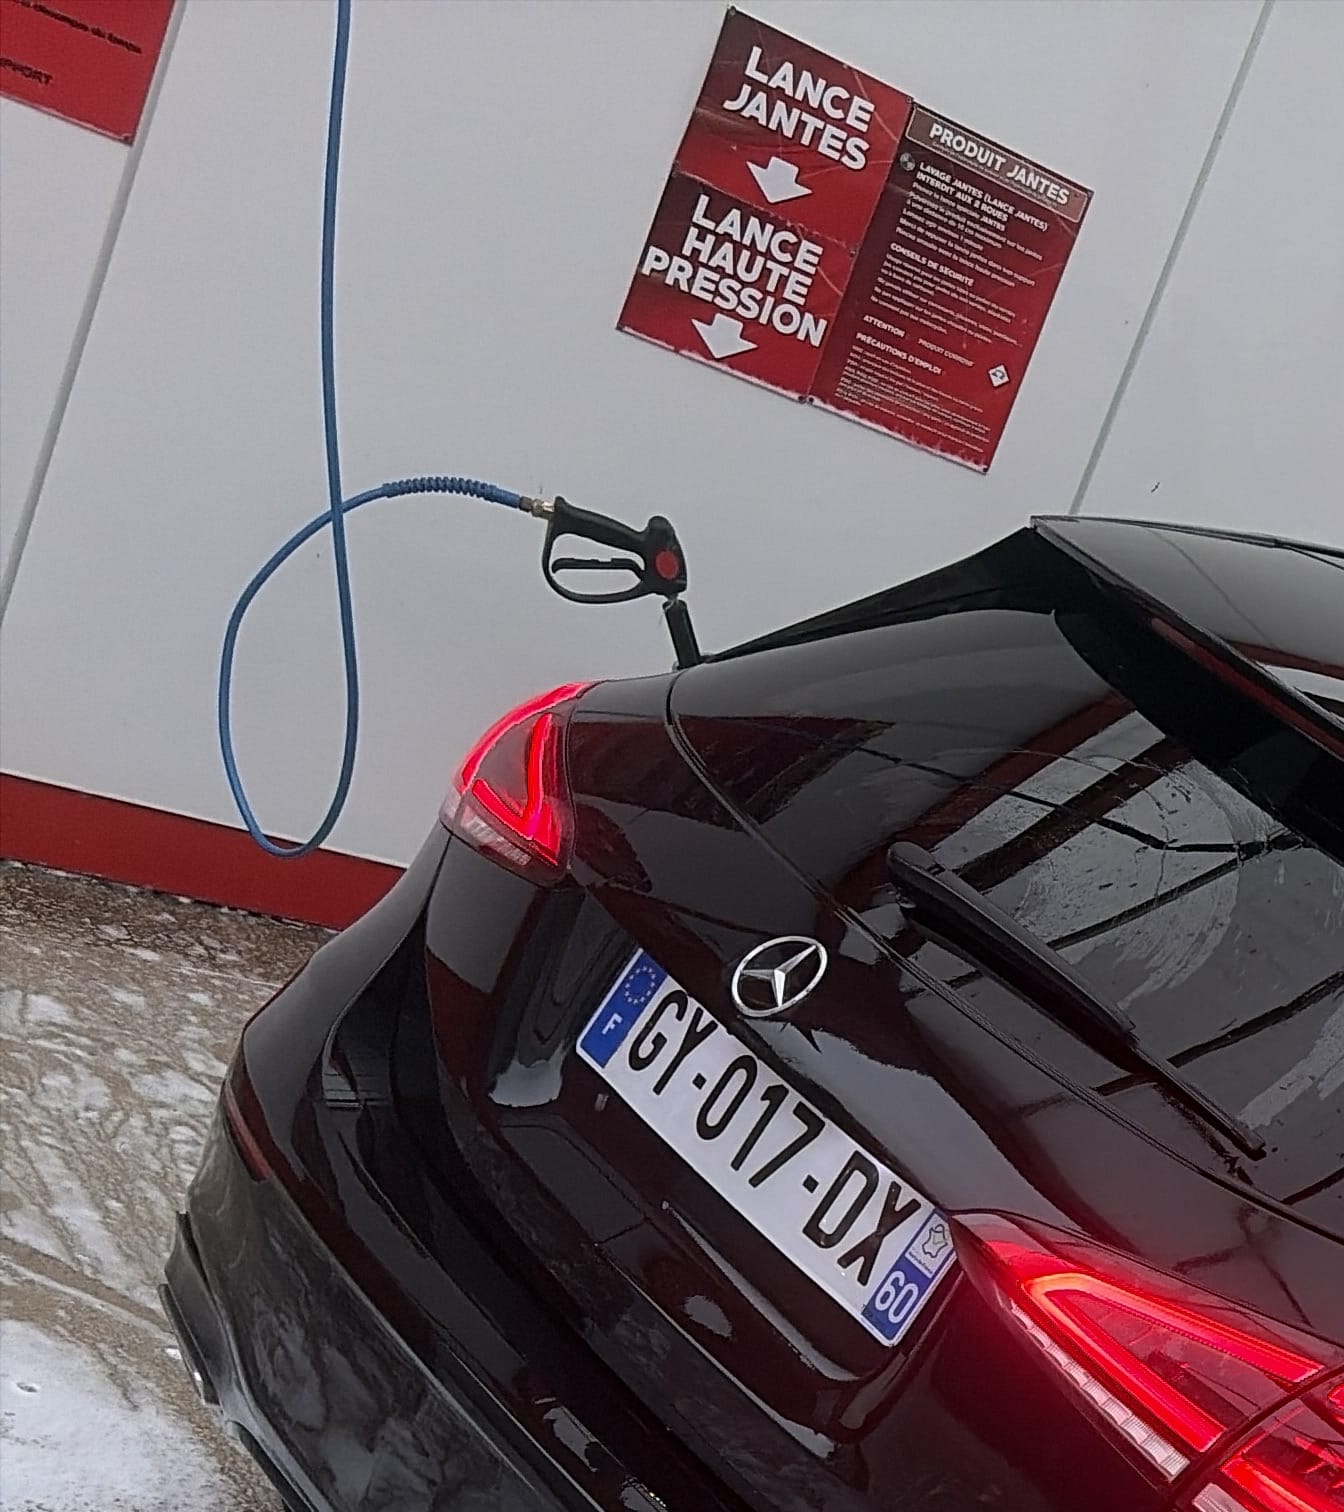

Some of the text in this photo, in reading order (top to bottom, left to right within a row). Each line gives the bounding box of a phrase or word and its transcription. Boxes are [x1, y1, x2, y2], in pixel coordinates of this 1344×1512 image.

[723, 84, 870, 171] JANTES
[744, 46, 875, 133] LANCE
[915, 171, 955, 196] INTERDIT
[954, 190, 973, 204] AUX
[980, 202, 1008, 222] ROUES
[918, 161, 1049, 233] LAVAGE JANTES (LANCE JANTES)
[928, 122, 1006, 173] PRODUIT
[1005, 161, 1070, 206] JANTES
[681, 227, 812, 305] HAUTE
[691, 194, 824, 274] LANCE
[889, 242, 927, 265] CONSEILS
[926, 259, 938, 270] DE
[641, 246, 828, 348] PRESSION
[862, 314, 905, 338] ATTENTION
[602, 1012, 624, 1035] F
[627, 989, 922, 1287] GY-017-DX
[874, 1269, 919, 1324] 60
